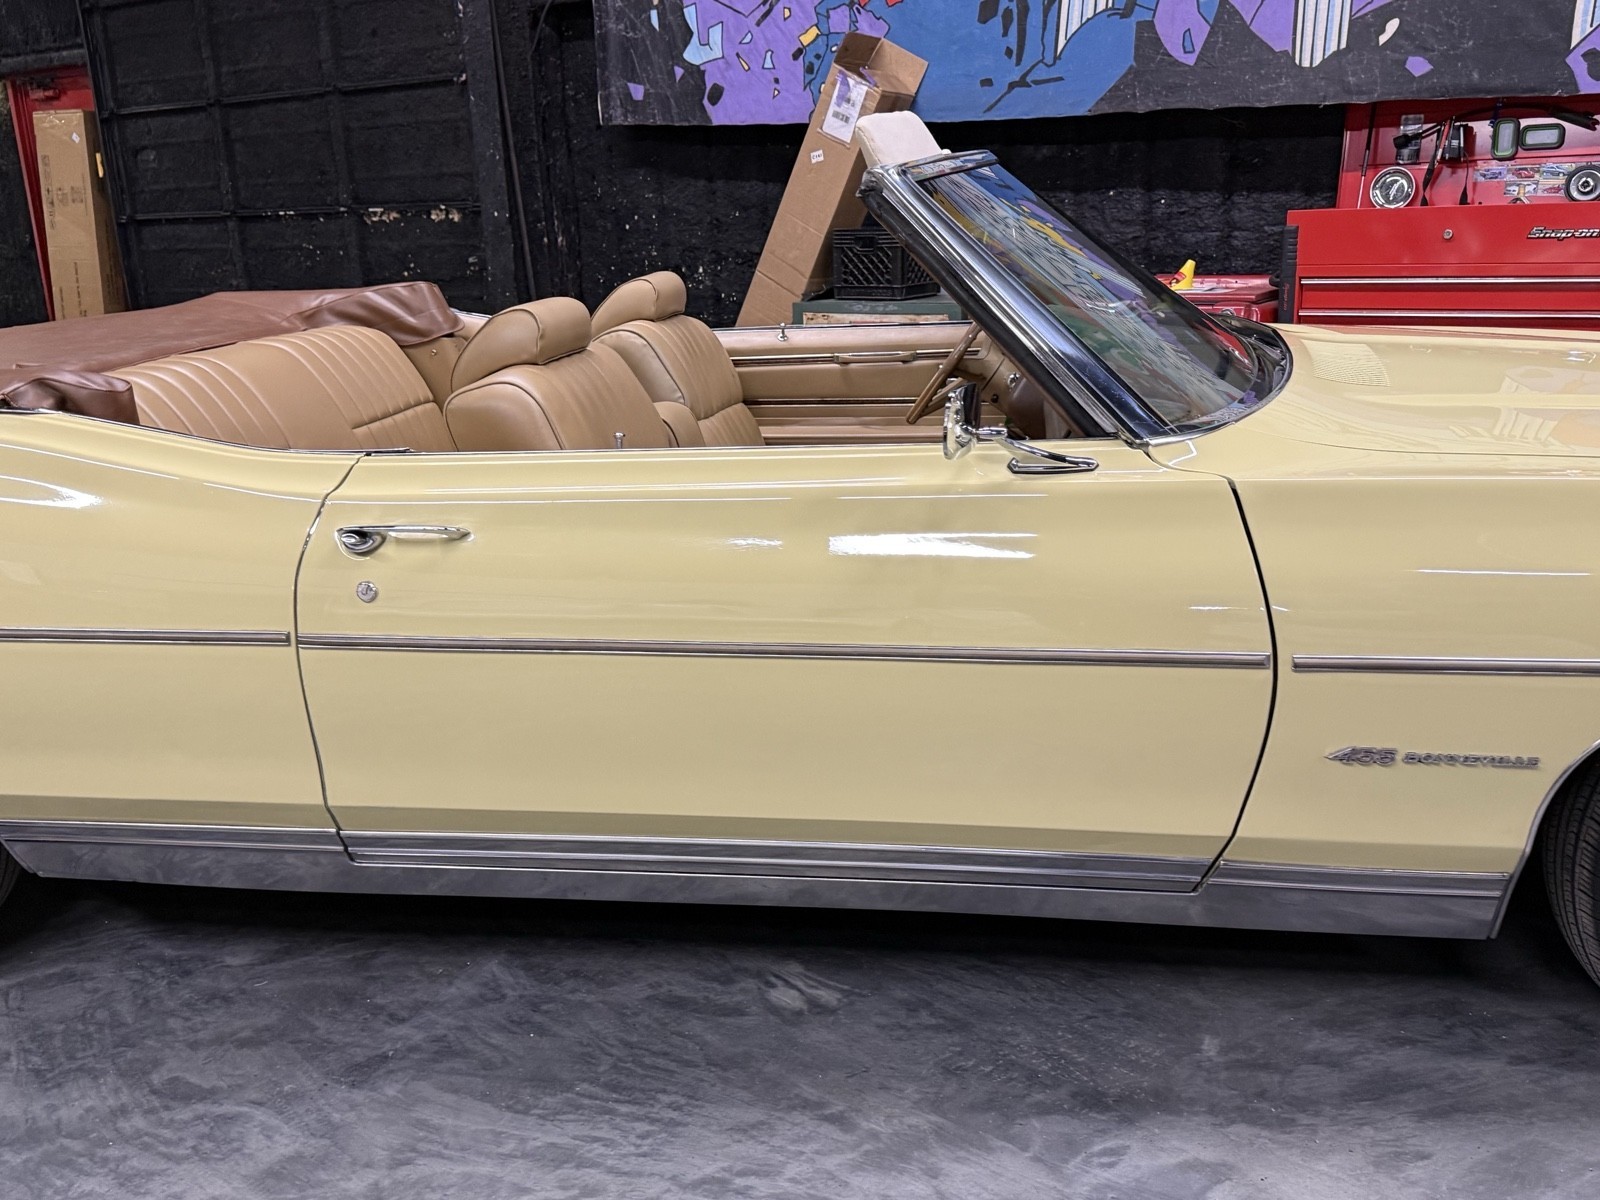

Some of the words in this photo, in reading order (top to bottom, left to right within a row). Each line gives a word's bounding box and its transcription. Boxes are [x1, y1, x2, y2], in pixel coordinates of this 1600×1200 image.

[1527, 226, 1600, 241] Snap-on
[1325, 746, 1397, 766] 455
[1402, 751, 1541, 769] BONNEVILLE
